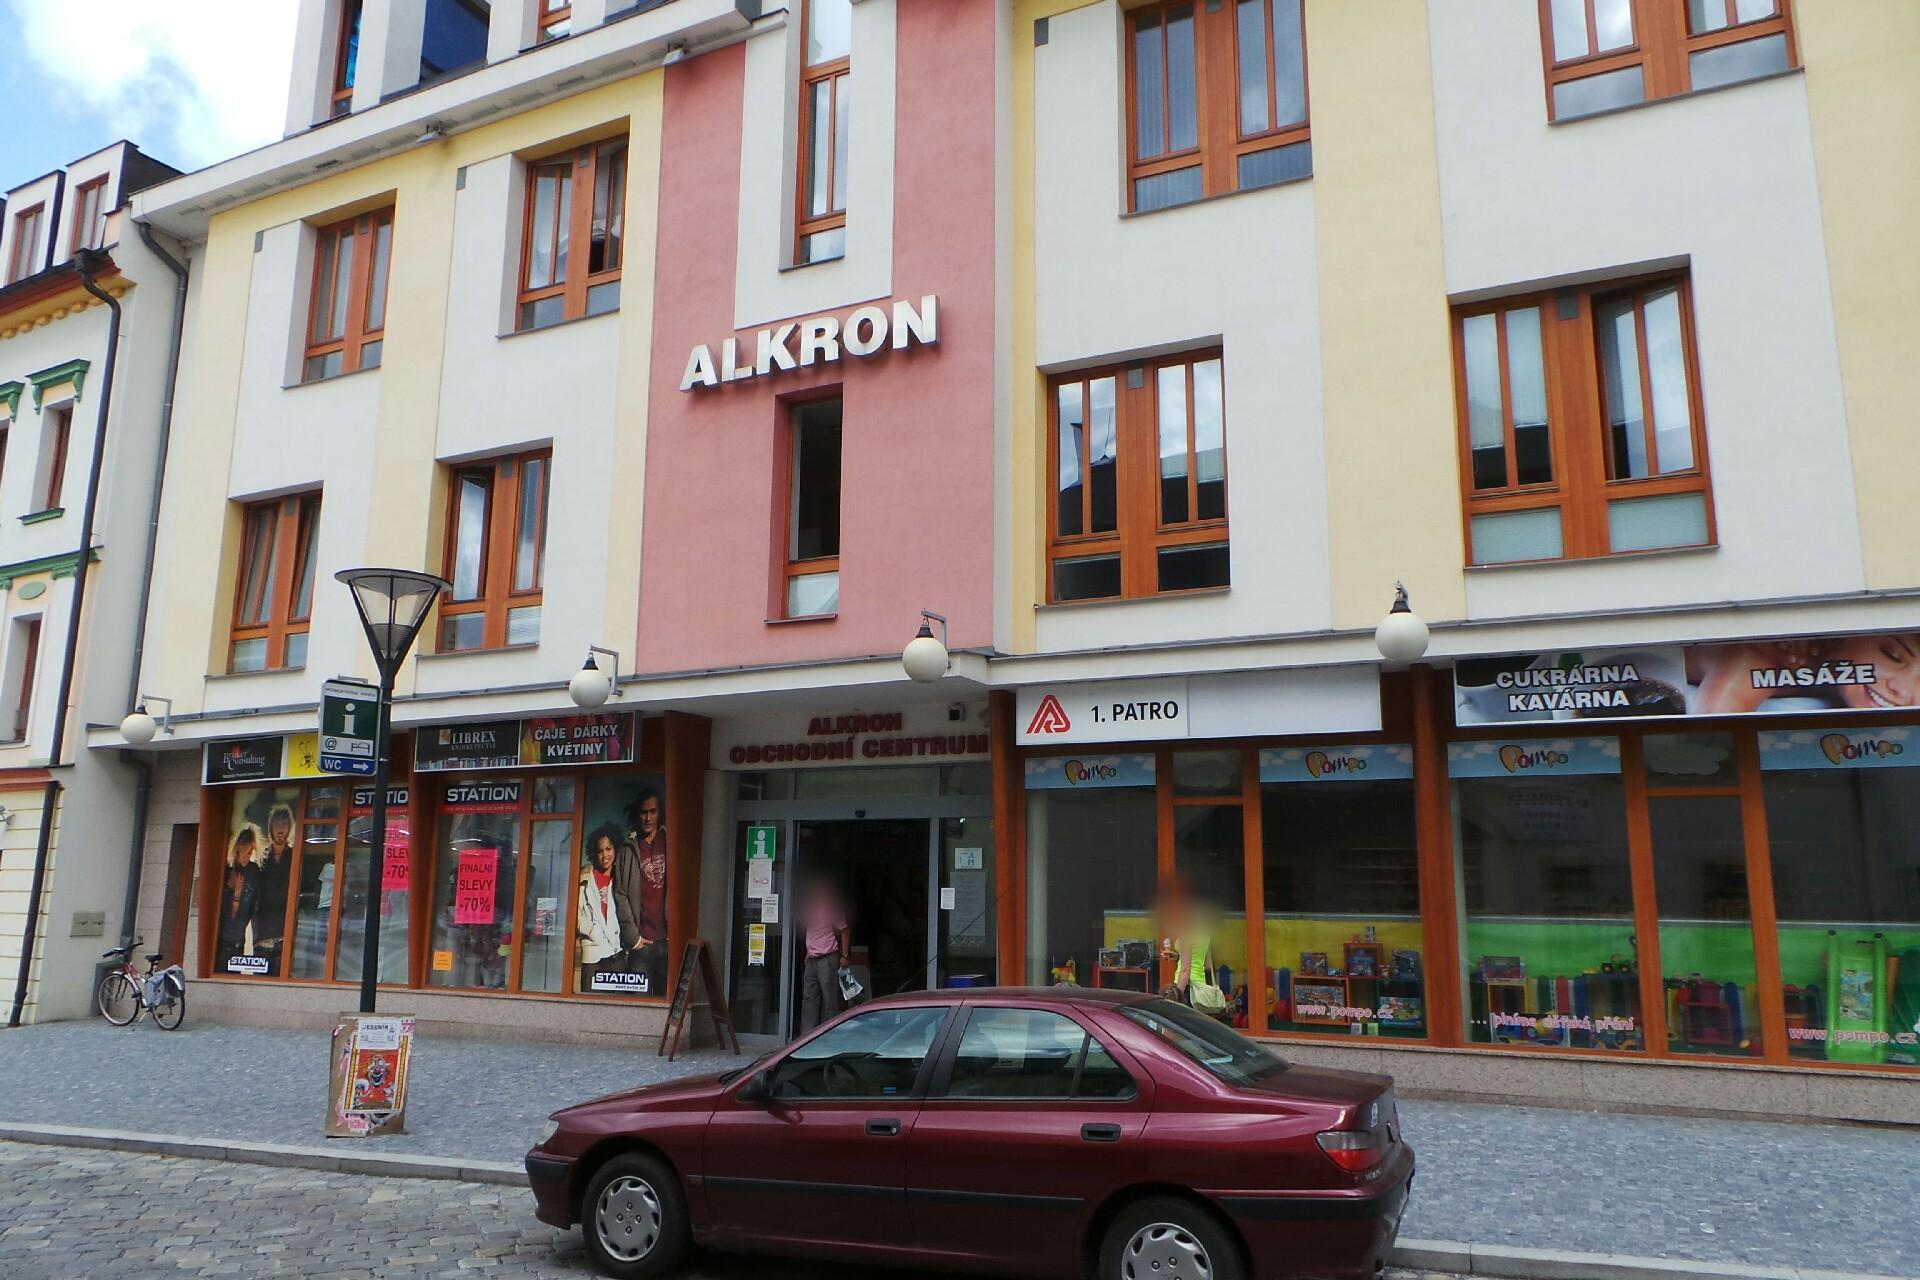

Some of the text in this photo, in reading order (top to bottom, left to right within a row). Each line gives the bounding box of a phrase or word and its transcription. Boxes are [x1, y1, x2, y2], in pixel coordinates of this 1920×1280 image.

[680, 294, 938, 391] ALKRON
[1496, 664, 1640, 688] CUKRÁRNA
[1751, 661, 1877, 689] MASÁŽE
[1508, 687, 1630, 712] KAVÁRNA
[1091, 700, 1179, 723] 1. PATRO
[534, 723, 619, 741] ČAJE DÁRKY
[807, 713, 903, 736] ALKRON
[452, 731, 496, 744] LIBREX
[547, 742, 604, 757] KVĚTINY
[729, 734, 989, 764] OBCHODNÍ CENTRUM
[324, 759, 342, 770] WC
[354, 790, 408, 805] STTIO
[447, 786, 518, 802] STATION
[386, 865, 408, 878] -70
[459, 879, 493, 891] SLEVY
[459, 897, 491, 913] -70%
[231, 956, 266, 966] STATION
[595, 972, 645, 984] STATION
[1296, 1004, 1393, 1020] www.pompo.cz
